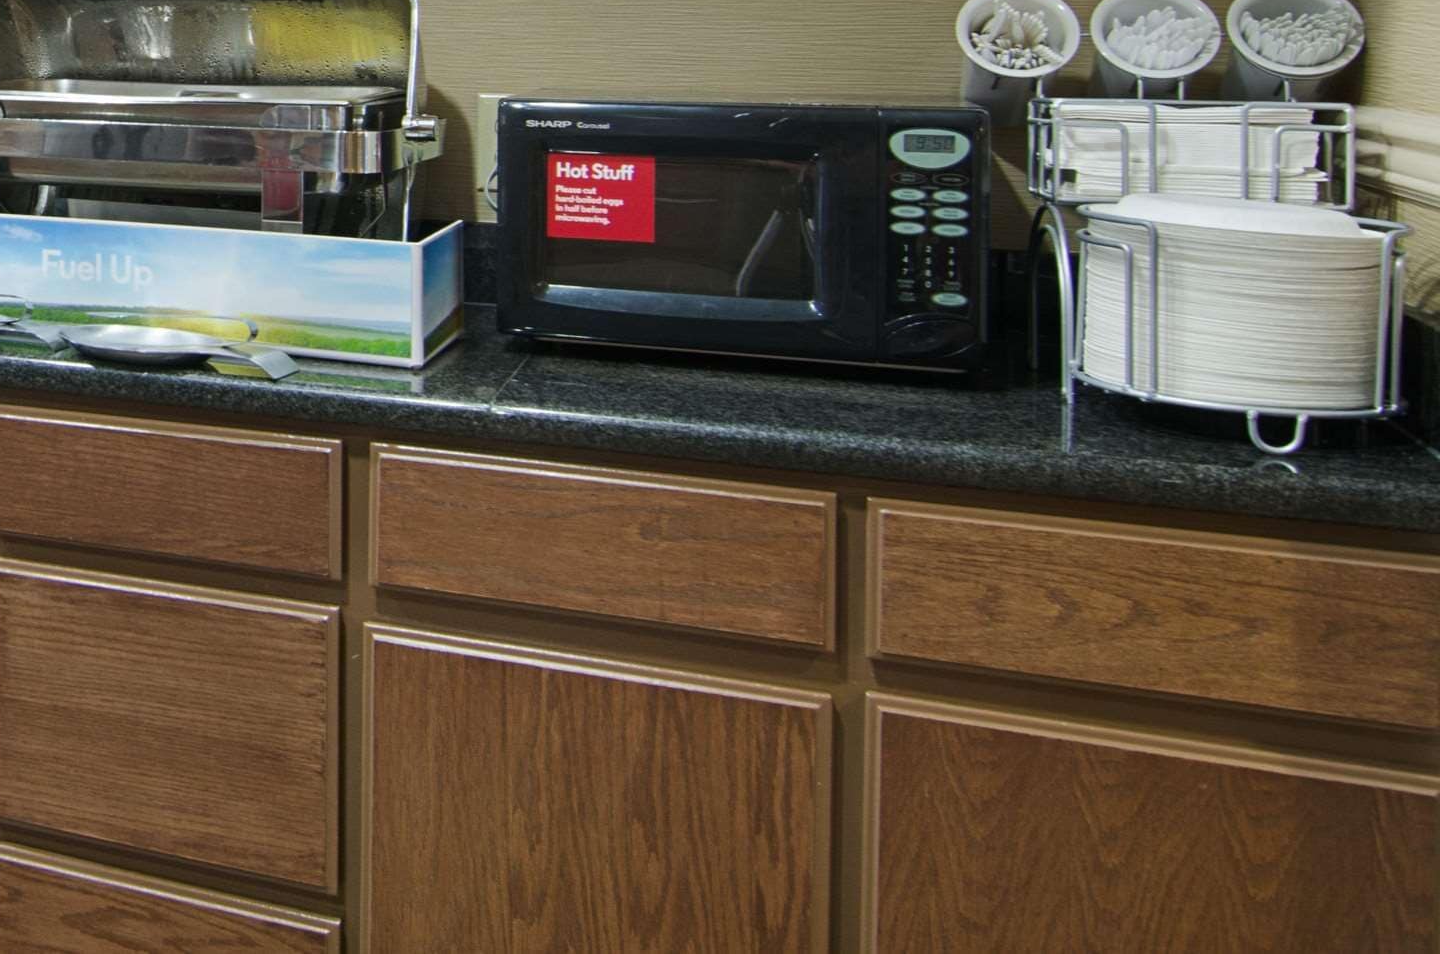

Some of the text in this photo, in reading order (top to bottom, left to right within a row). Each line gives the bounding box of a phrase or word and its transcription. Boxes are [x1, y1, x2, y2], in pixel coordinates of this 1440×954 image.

[525, 119, 572, 128] SHARP
[556, 161, 635, 181] Hot Stuff
[555, 185, 597, 195] Please cut
[555, 194, 624, 207] hard-boiled eggs
[555, 204, 608, 215] in half before
[555, 214, 611, 226] microwaving.
[41, 248, 153, 291] Fuel Up
